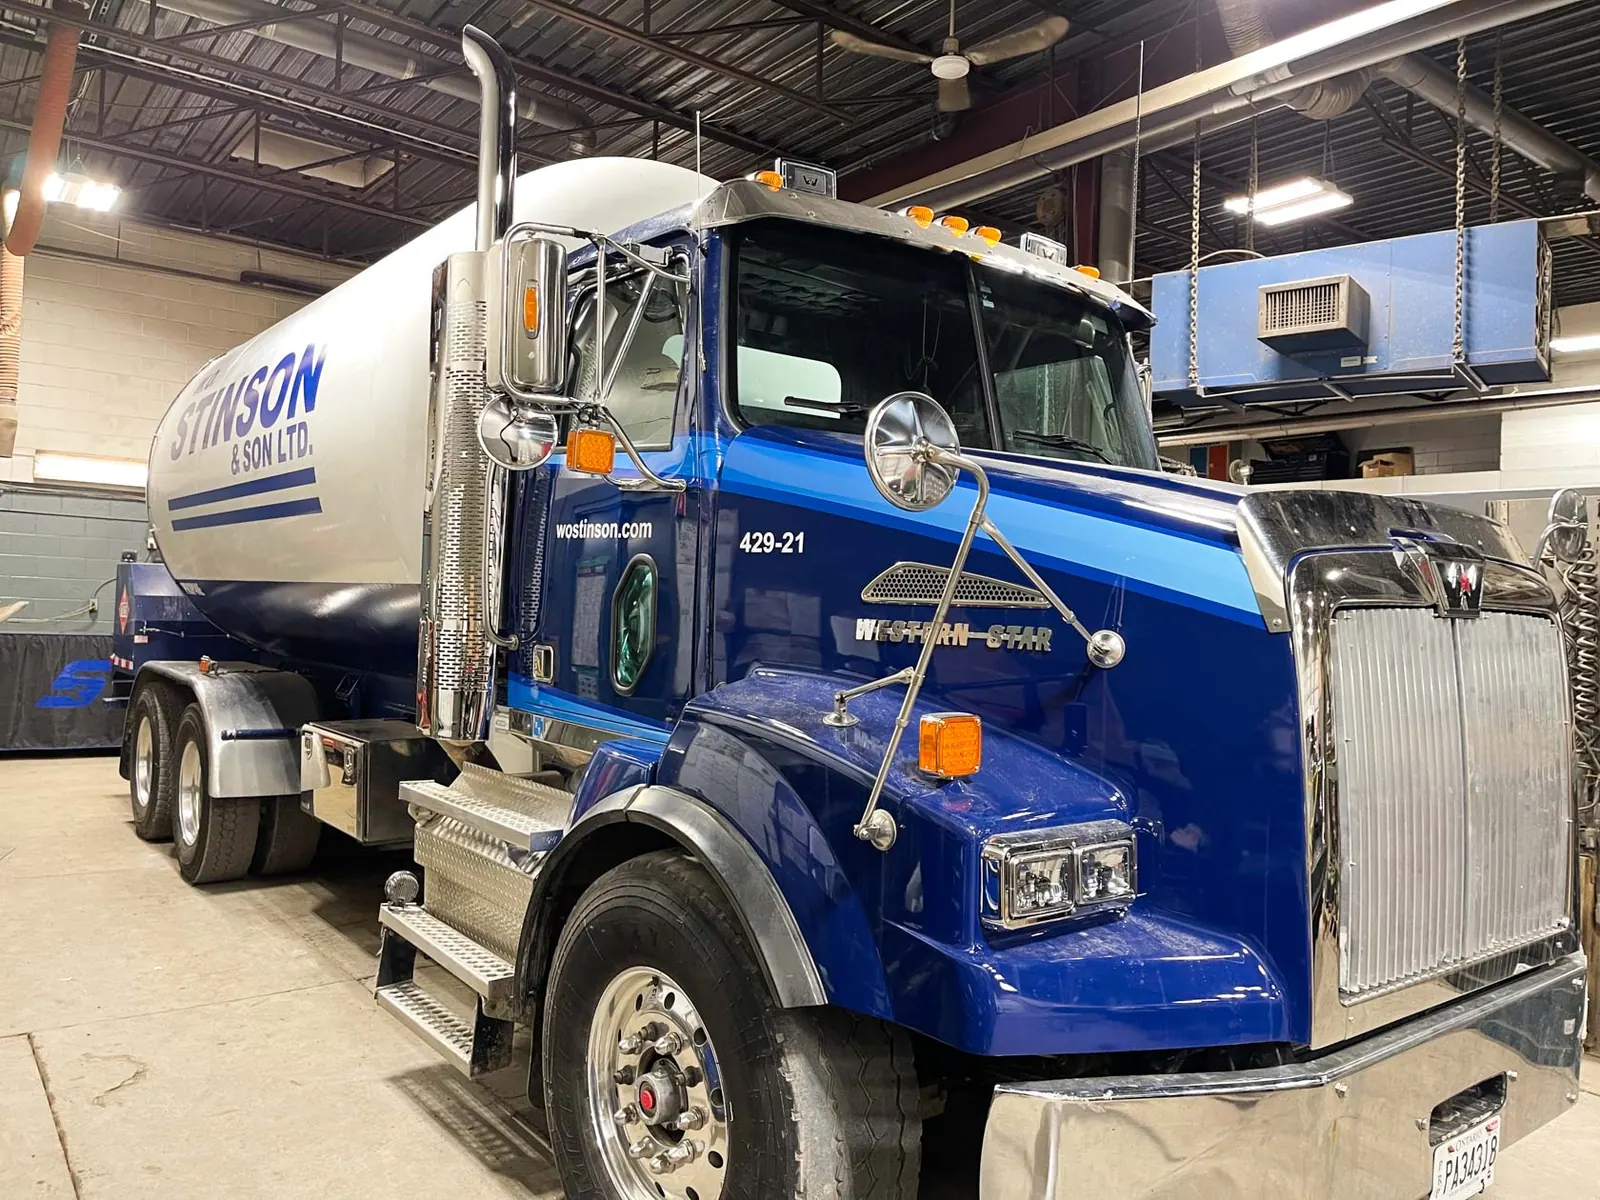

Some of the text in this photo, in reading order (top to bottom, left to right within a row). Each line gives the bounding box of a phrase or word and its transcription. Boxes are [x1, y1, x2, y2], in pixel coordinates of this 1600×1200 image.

[170, 343, 328, 461] STINSON
[231, 421, 314, 475] & SON LTD.
[556, 518, 653, 539] wostinson.com
[739, 531, 805, 553] 429-21
[986, 624, 1053, 652] STAR
[1443, 1135, 1498, 1195] PA34318
